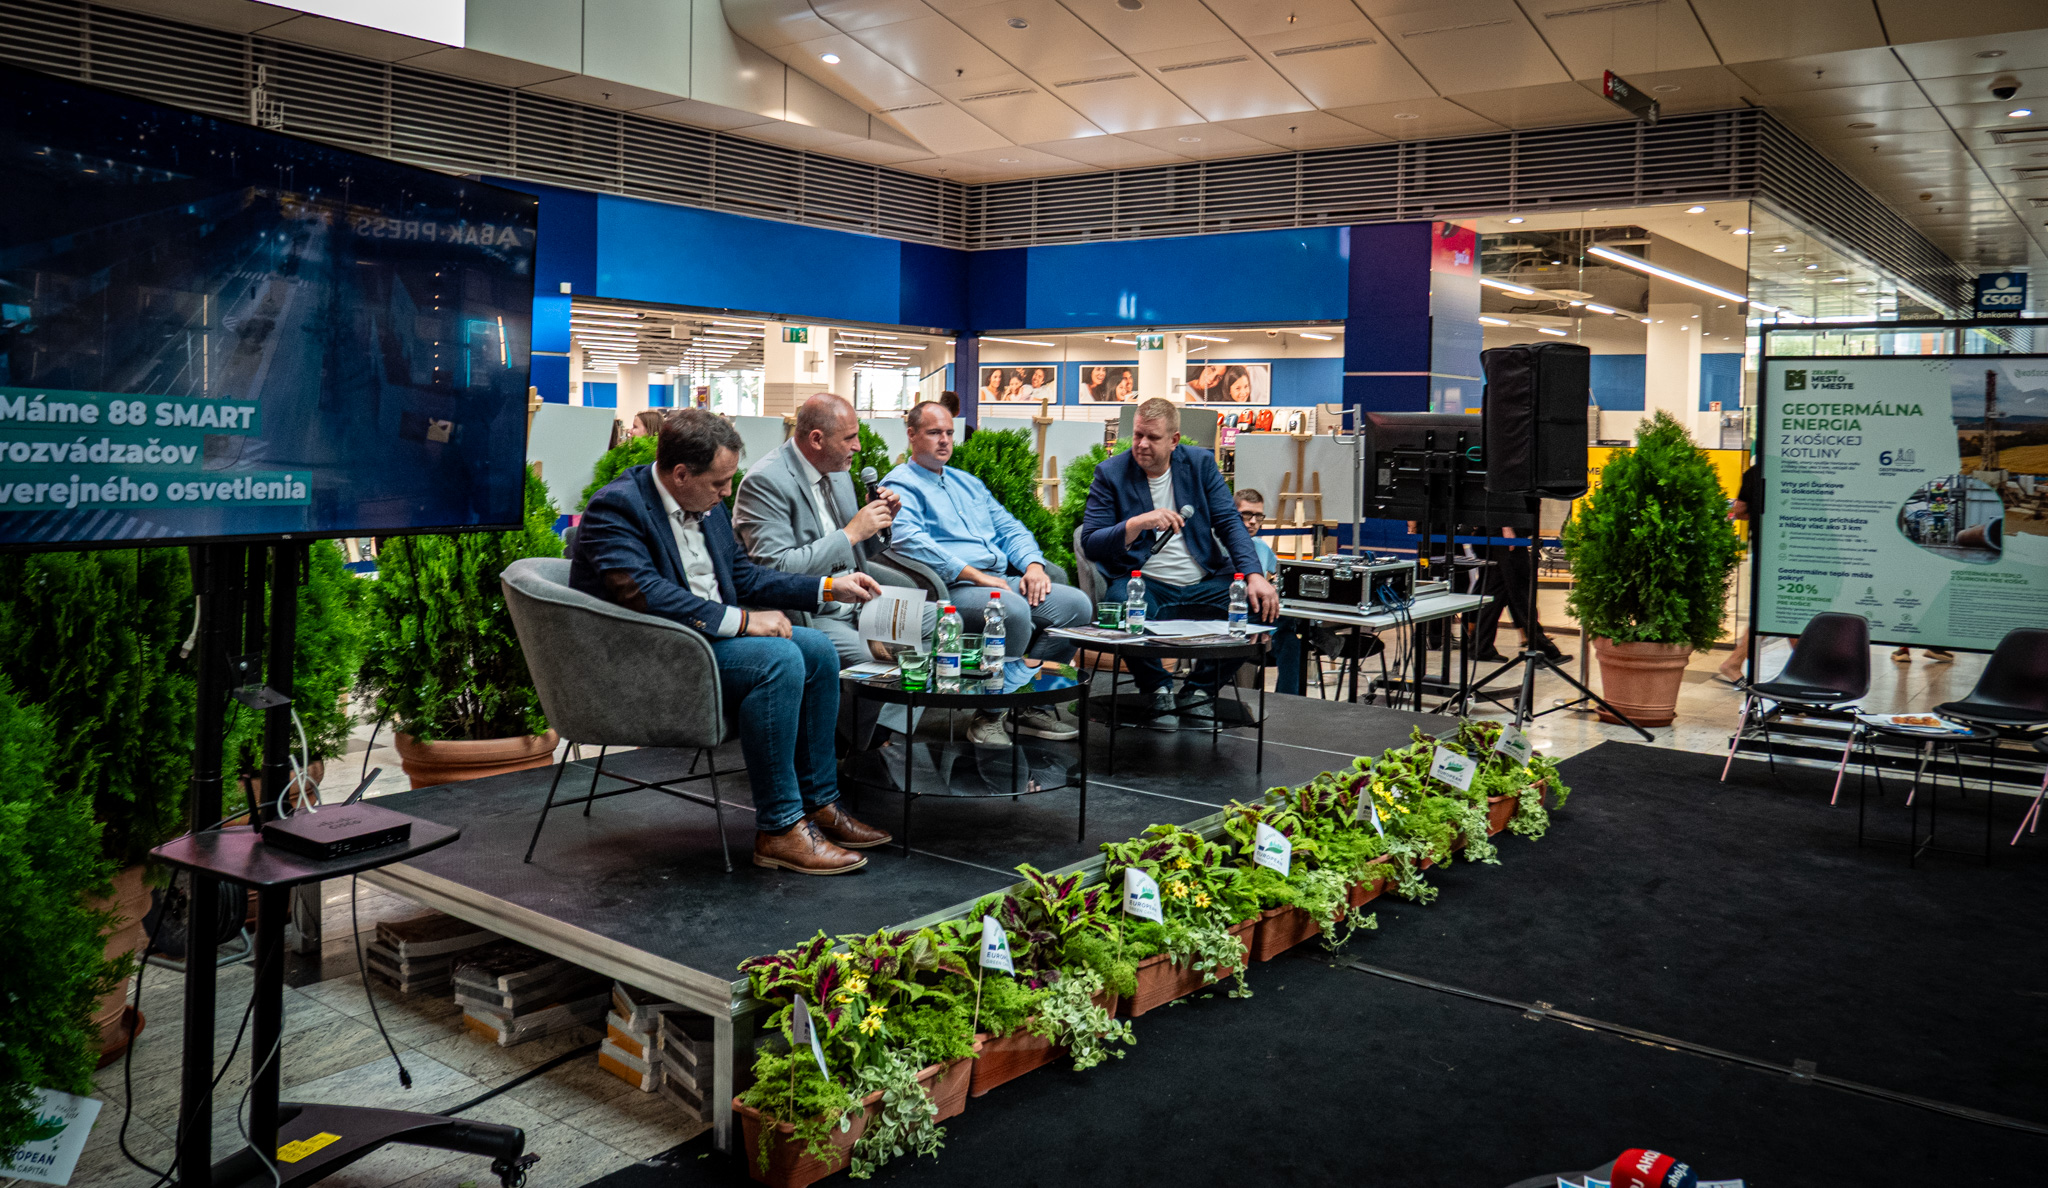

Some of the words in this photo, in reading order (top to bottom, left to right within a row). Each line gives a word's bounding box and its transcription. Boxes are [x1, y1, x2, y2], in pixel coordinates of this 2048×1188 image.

[1981, 294, 2023, 305] ČSOB
[1977, 311, 2018, 319] Bankomat
[0, 394, 100, 424] Máme
[108, 400, 147, 426] 88
[155, 402, 255, 429] SMART
[1782, 400, 1923, 416] GEOTERMÁLNA
[1782, 418, 1862, 431] ENERGIA
[1781, 435, 1790, 445] Z
[1794, 433, 1863, 446] KOŠICKEJ
[1781, 448, 1841, 458] KOTLINY
[1879, 451, 1892, 466] 6
[166, 474, 307, 501] osvetlenia
[1780, 481, 1797, 489] Vrty
[1799, 481, 1810, 489] pri
[1829, 517, 1868, 525] prichádza
[1778, 567, 1828, 576] Geotermálne
[1829, 569, 1850, 578] teplo
[1777, 583, 1818, 595] >20%
